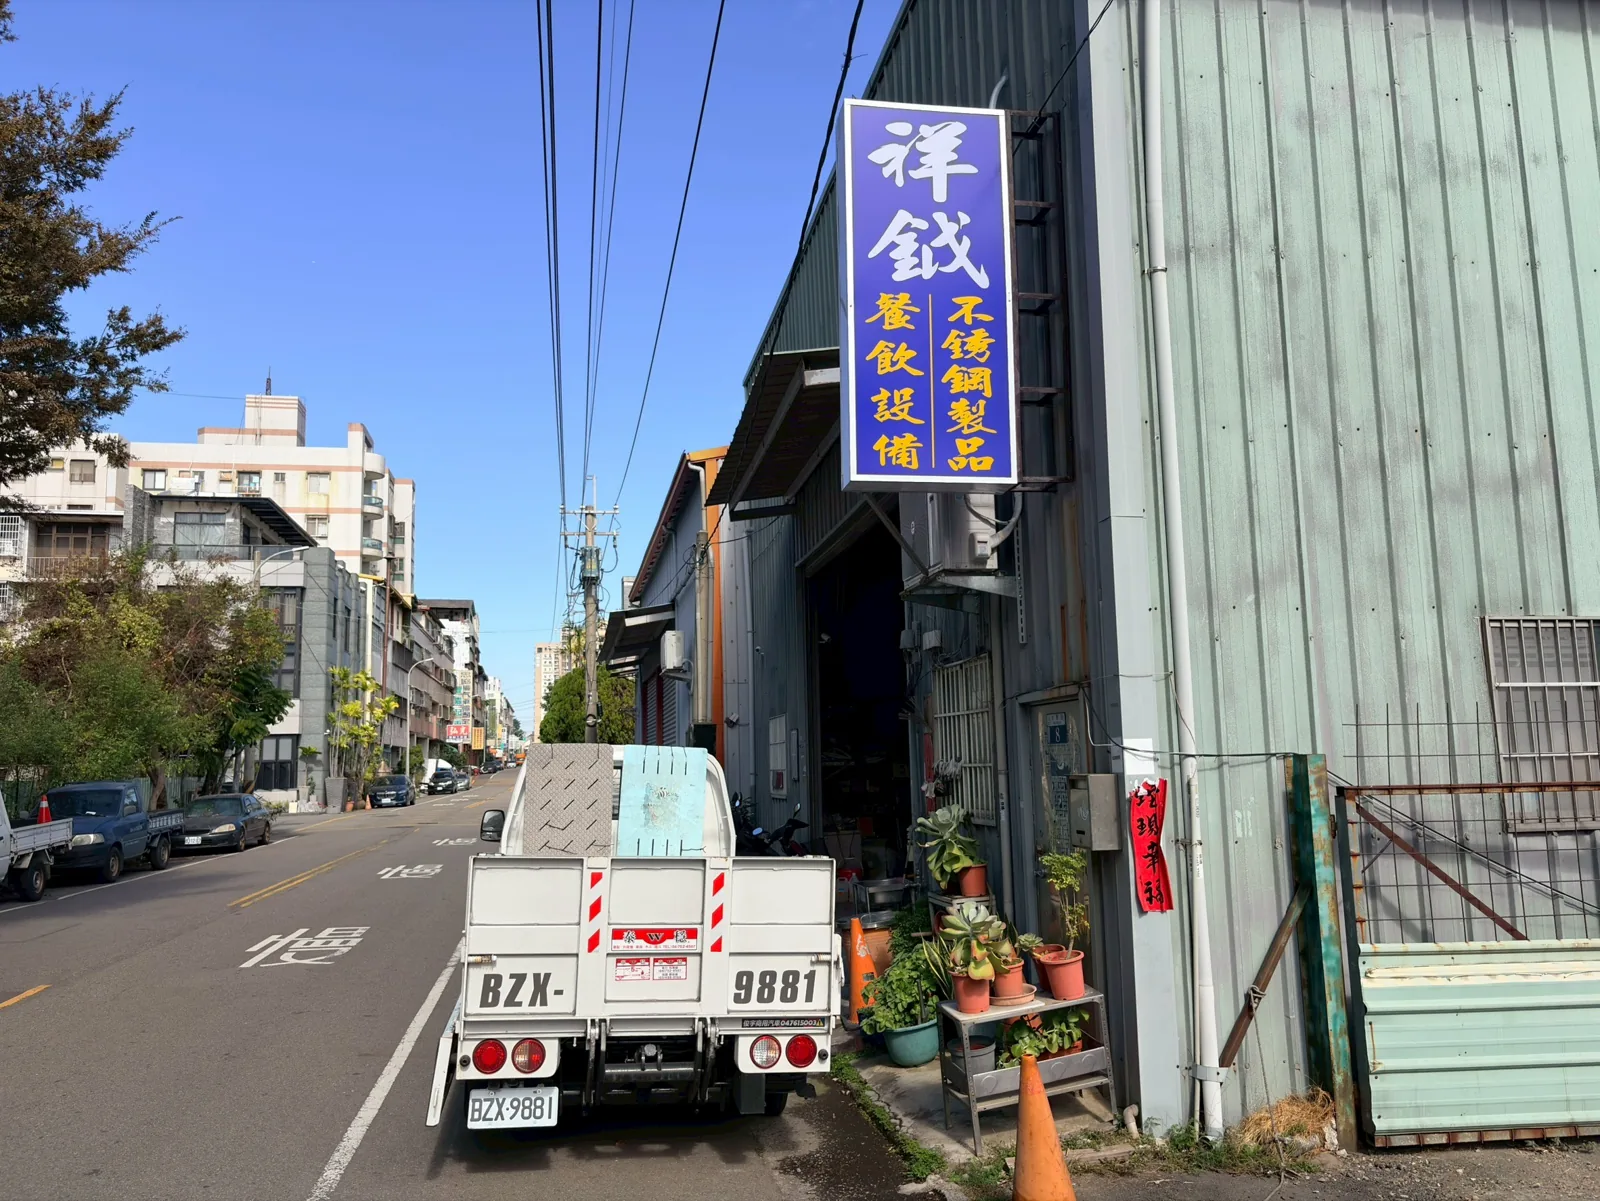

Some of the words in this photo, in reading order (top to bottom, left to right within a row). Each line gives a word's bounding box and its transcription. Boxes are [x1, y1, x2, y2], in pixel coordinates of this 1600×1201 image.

[864, 291, 926, 471] 餐飲設備
[940, 295, 998, 473] 不銹鋼製品
[1055, 727, 1061, 743] 8
[238, 926, 371, 968] 慢
[479, 972, 564, 1008] BZX-
[733, 969, 817, 1004] 9881
